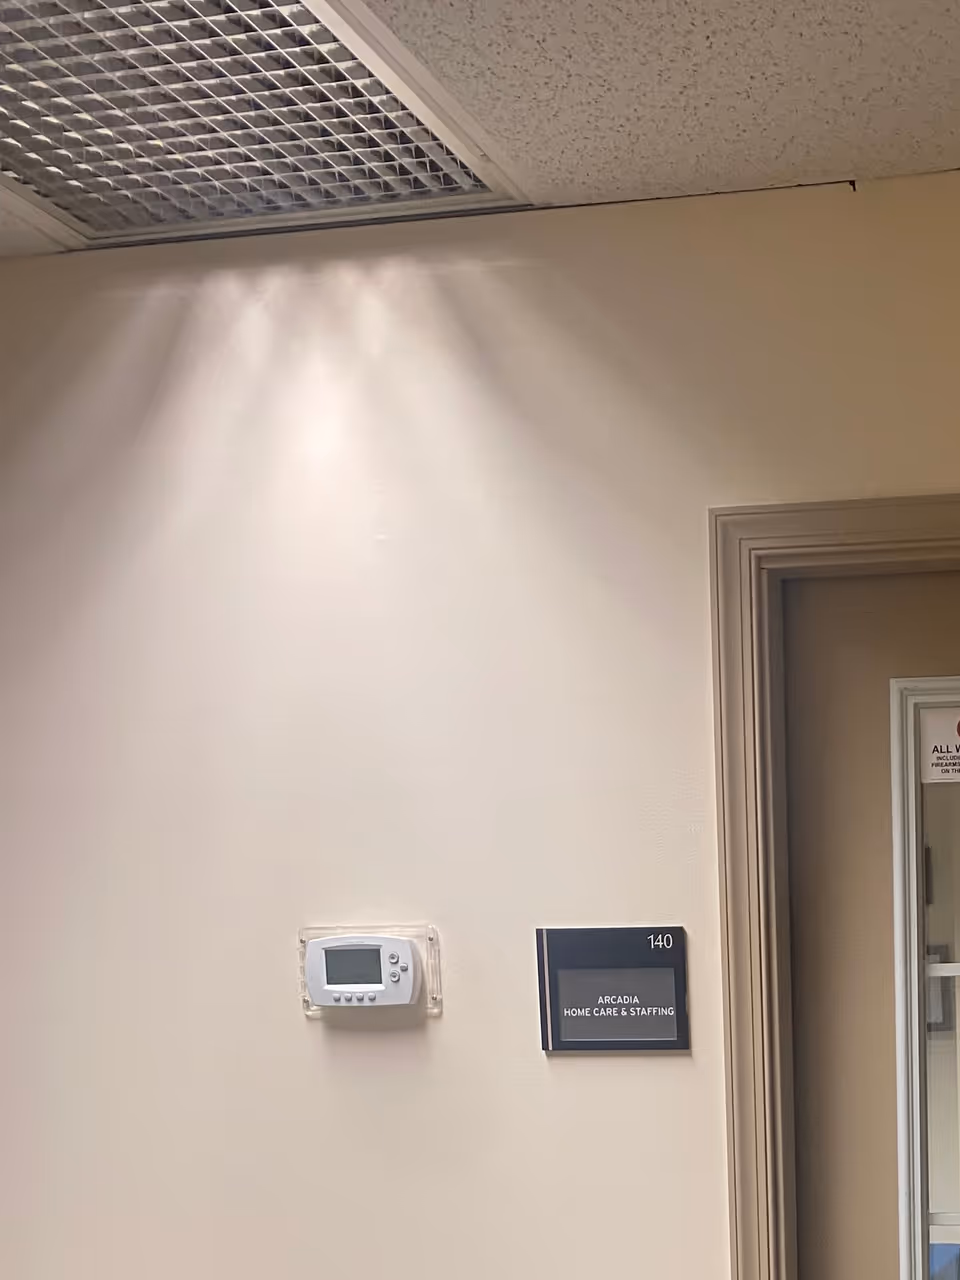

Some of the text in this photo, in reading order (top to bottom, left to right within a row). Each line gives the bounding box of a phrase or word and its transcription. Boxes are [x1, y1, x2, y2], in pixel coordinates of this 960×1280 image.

[932, 744, 952, 754] ALL
[647, 933, 673, 949] 140
[597, 995, 640, 1005] ARCADIA
[563, 1006, 675, 1017] HOME CARE & STAFFING
